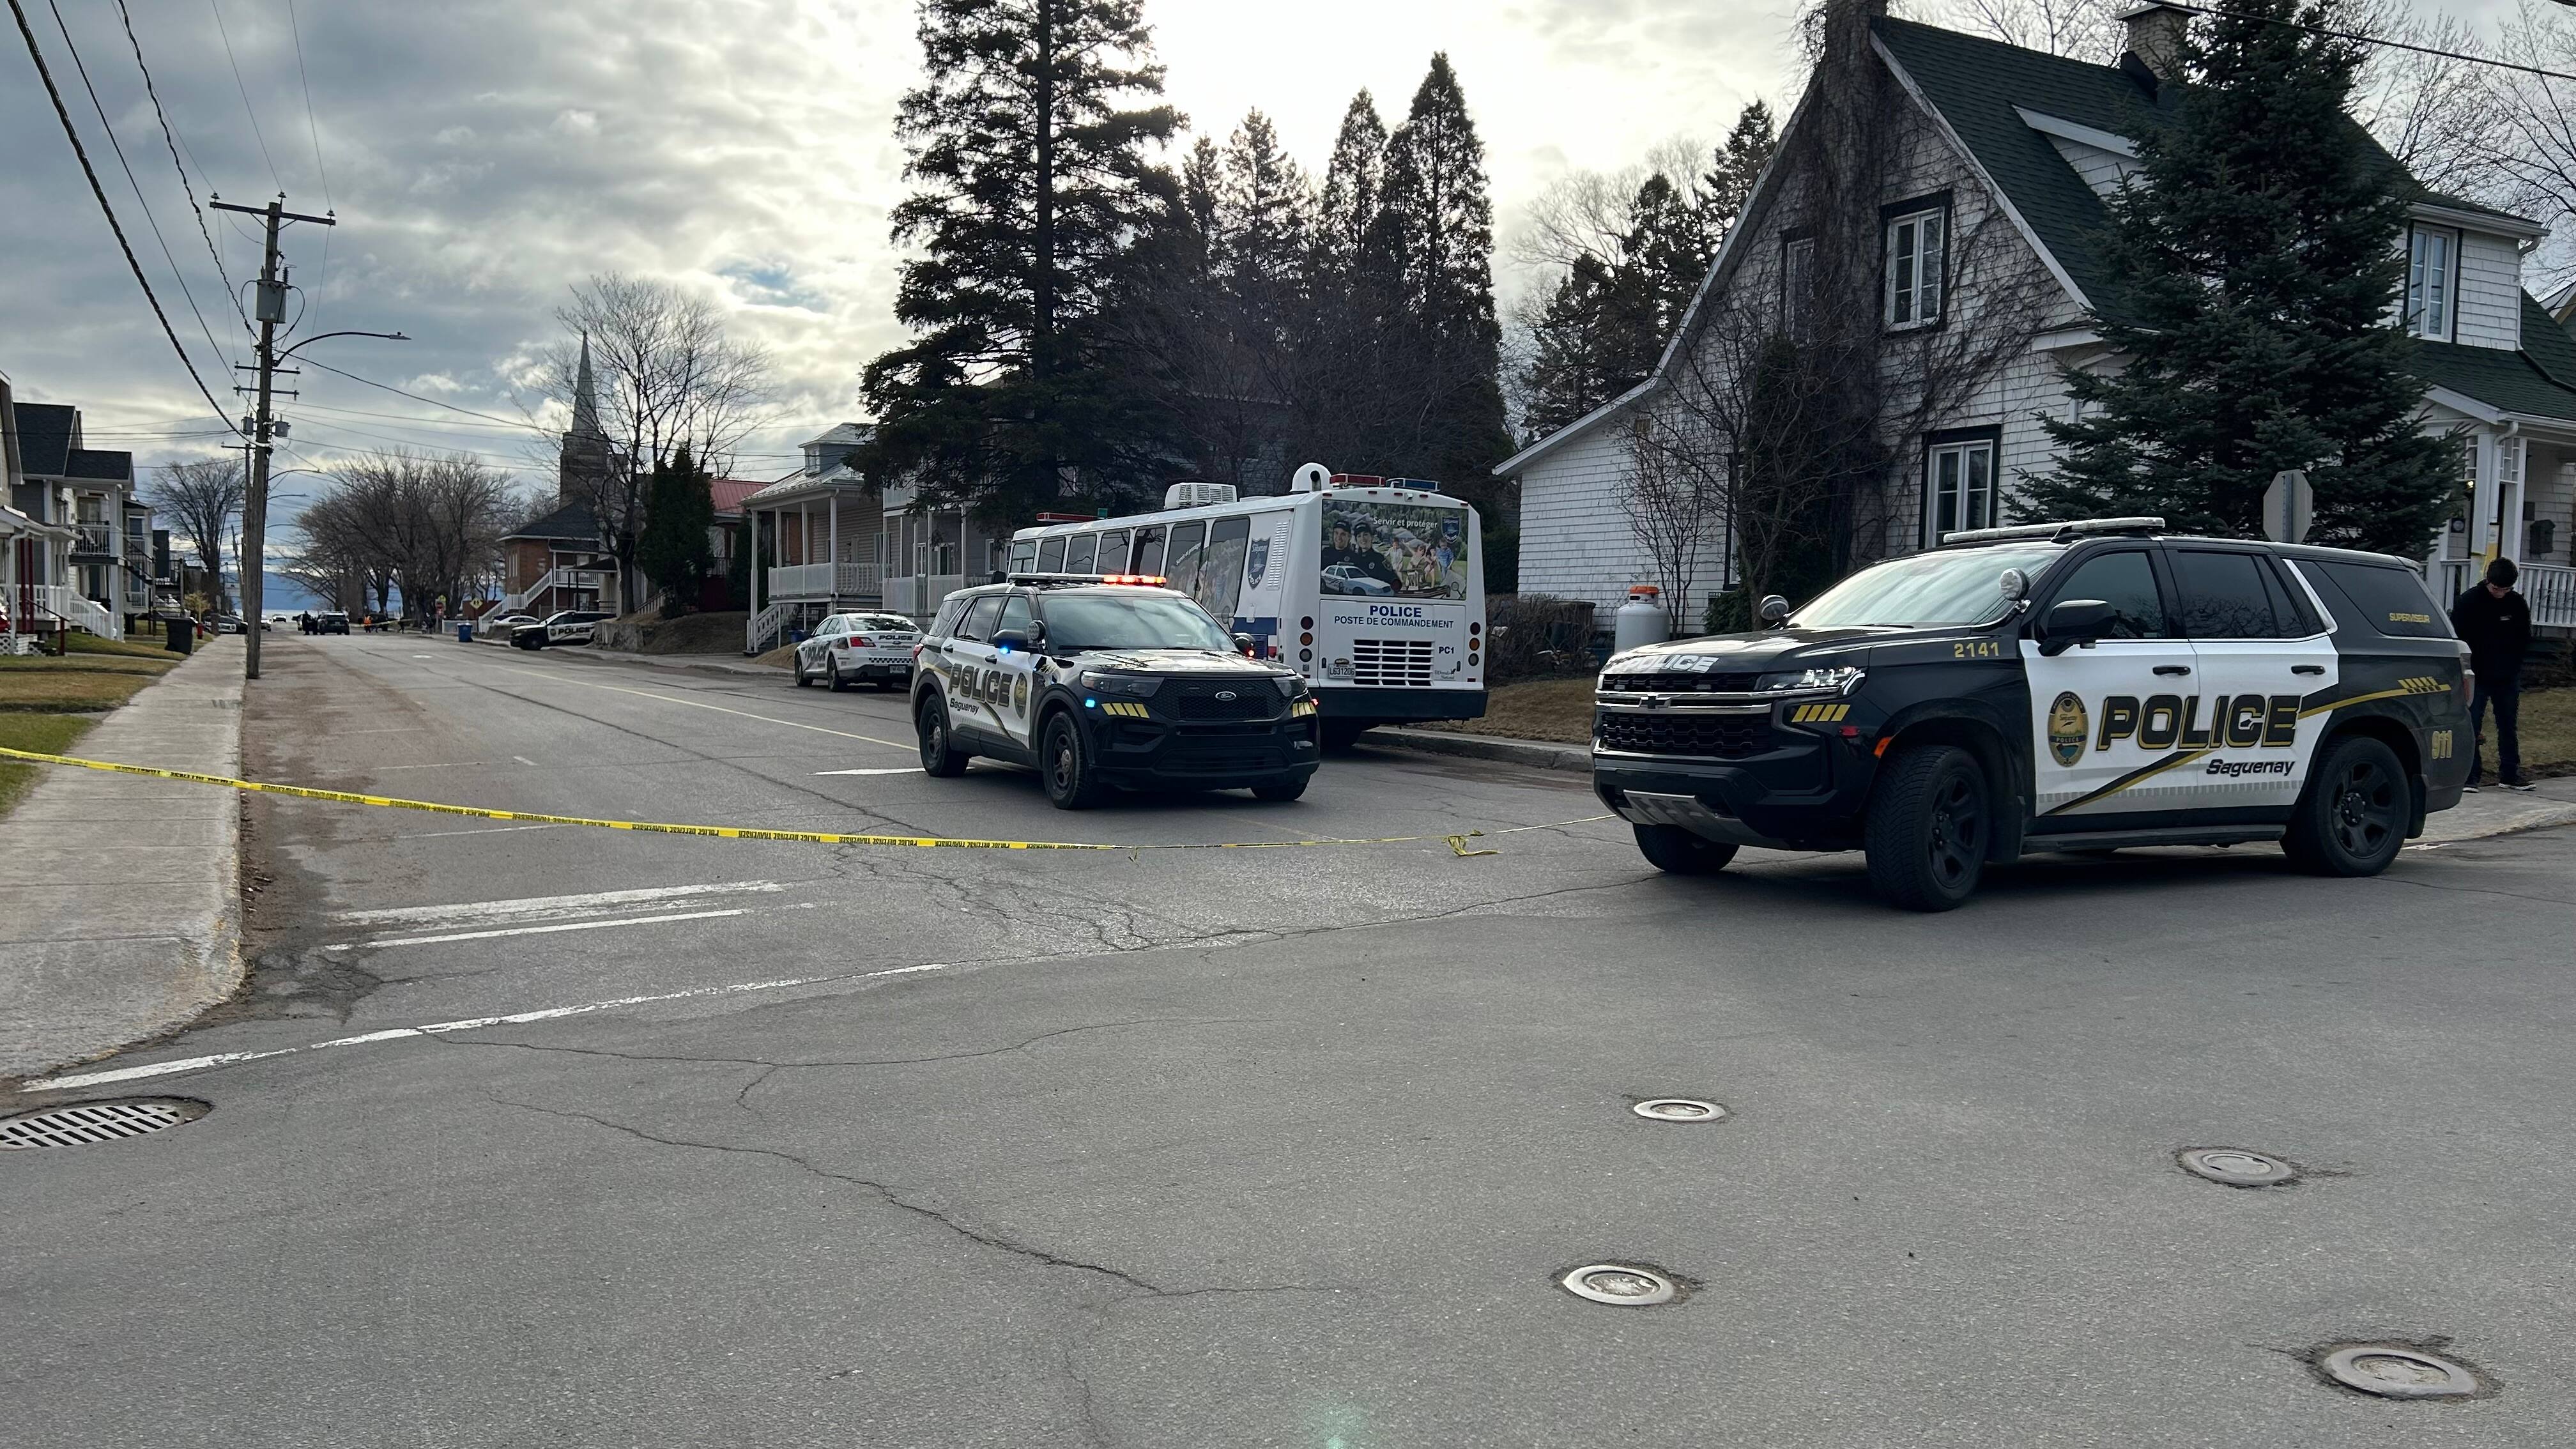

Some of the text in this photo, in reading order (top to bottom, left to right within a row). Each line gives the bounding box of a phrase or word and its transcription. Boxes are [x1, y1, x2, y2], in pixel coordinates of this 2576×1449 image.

[1373, 516, 1396, 526] Servir
[1406, 519, 1438, 530] protéger
[1369, 605, 1422, 618] POLICE
[1334, 615, 1454, 629] POSTE DE COMMANDEMENT
[558, 627, 590, 635] POLICE
[1438, 646, 1455, 655] PC1
[1954, 642, 1999, 658] 2141
[1621, 654, 1720, 673] POLICE
[947, 663, 1013, 707] POLICE
[949, 698, 979, 715] Saguenay
[2096, 694, 2301, 751] POLICE
[2432, 730, 2453, 760] 911
[2206, 758, 2296, 777] Saguenay
[698, 828, 719, 836] POLICE
[738, 830, 771, 840] TRAVERSER
[800, 834, 820, 843] POLICE
[838, 836, 871, 845] TRAVERSER
